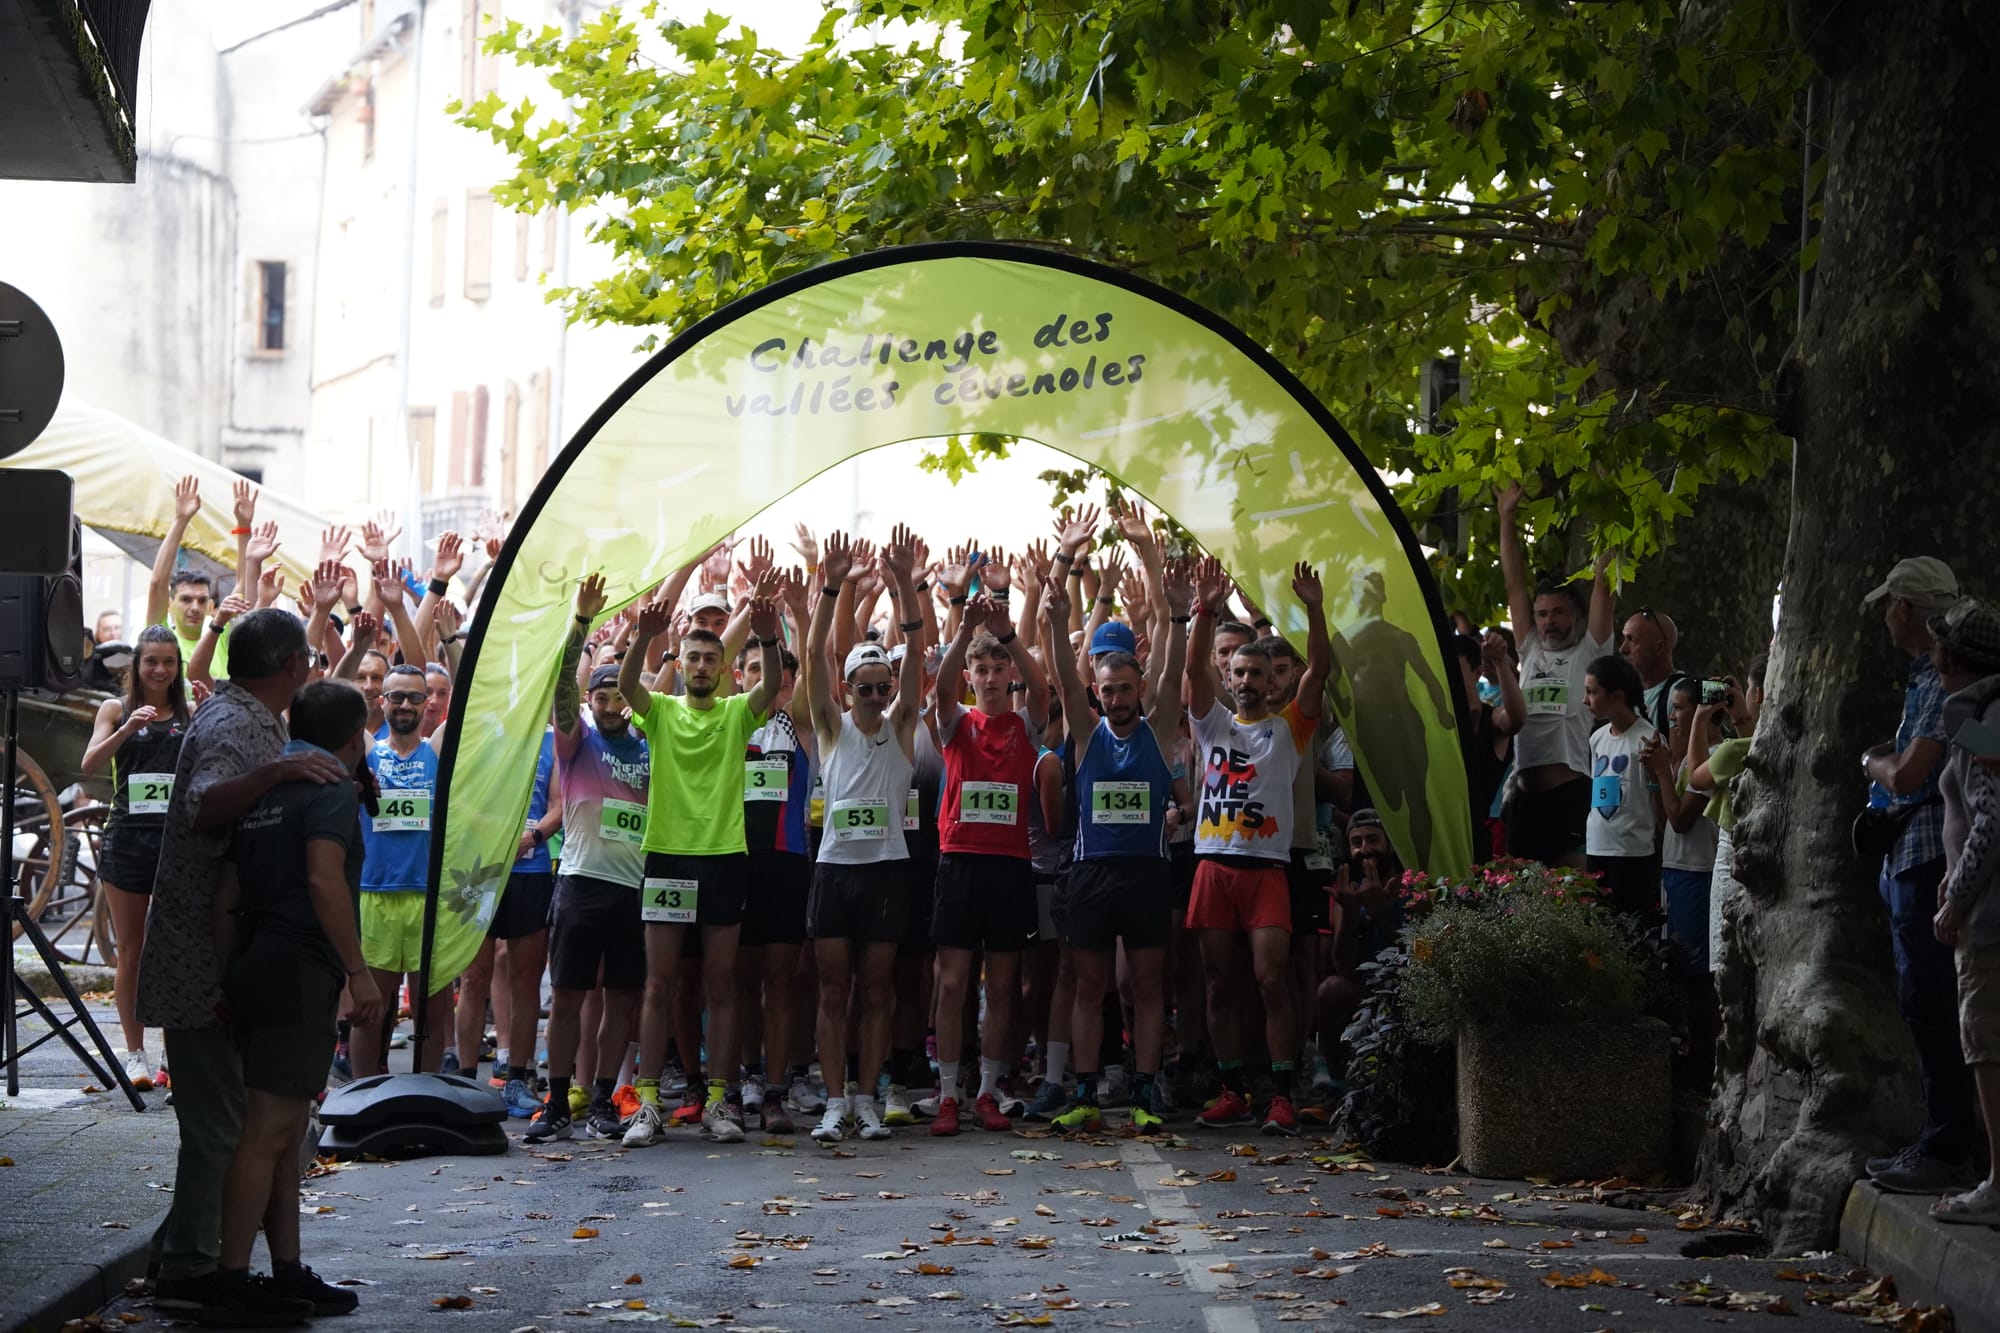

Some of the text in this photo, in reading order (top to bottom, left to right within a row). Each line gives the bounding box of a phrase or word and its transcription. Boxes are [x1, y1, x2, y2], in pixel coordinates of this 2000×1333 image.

[750, 312, 1113, 373] Challenge des
[726, 354, 1146, 417] vallées cévenoles
[1209, 746, 1250, 772] DE
[753, 772, 766, 787] 3
[1204, 774, 1249, 800] ME
[144, 784, 169, 800] 21
[970, 792, 1010, 810] 113
[1101, 792, 1142, 810] 134
[1600, 788, 1608, 800] 5
[385, 800, 415, 817] 46
[1201, 801, 1265, 829] NTS
[616, 812, 642, 831] 60
[847, 809, 875, 827] 53
[654, 890, 682, 908] 43
